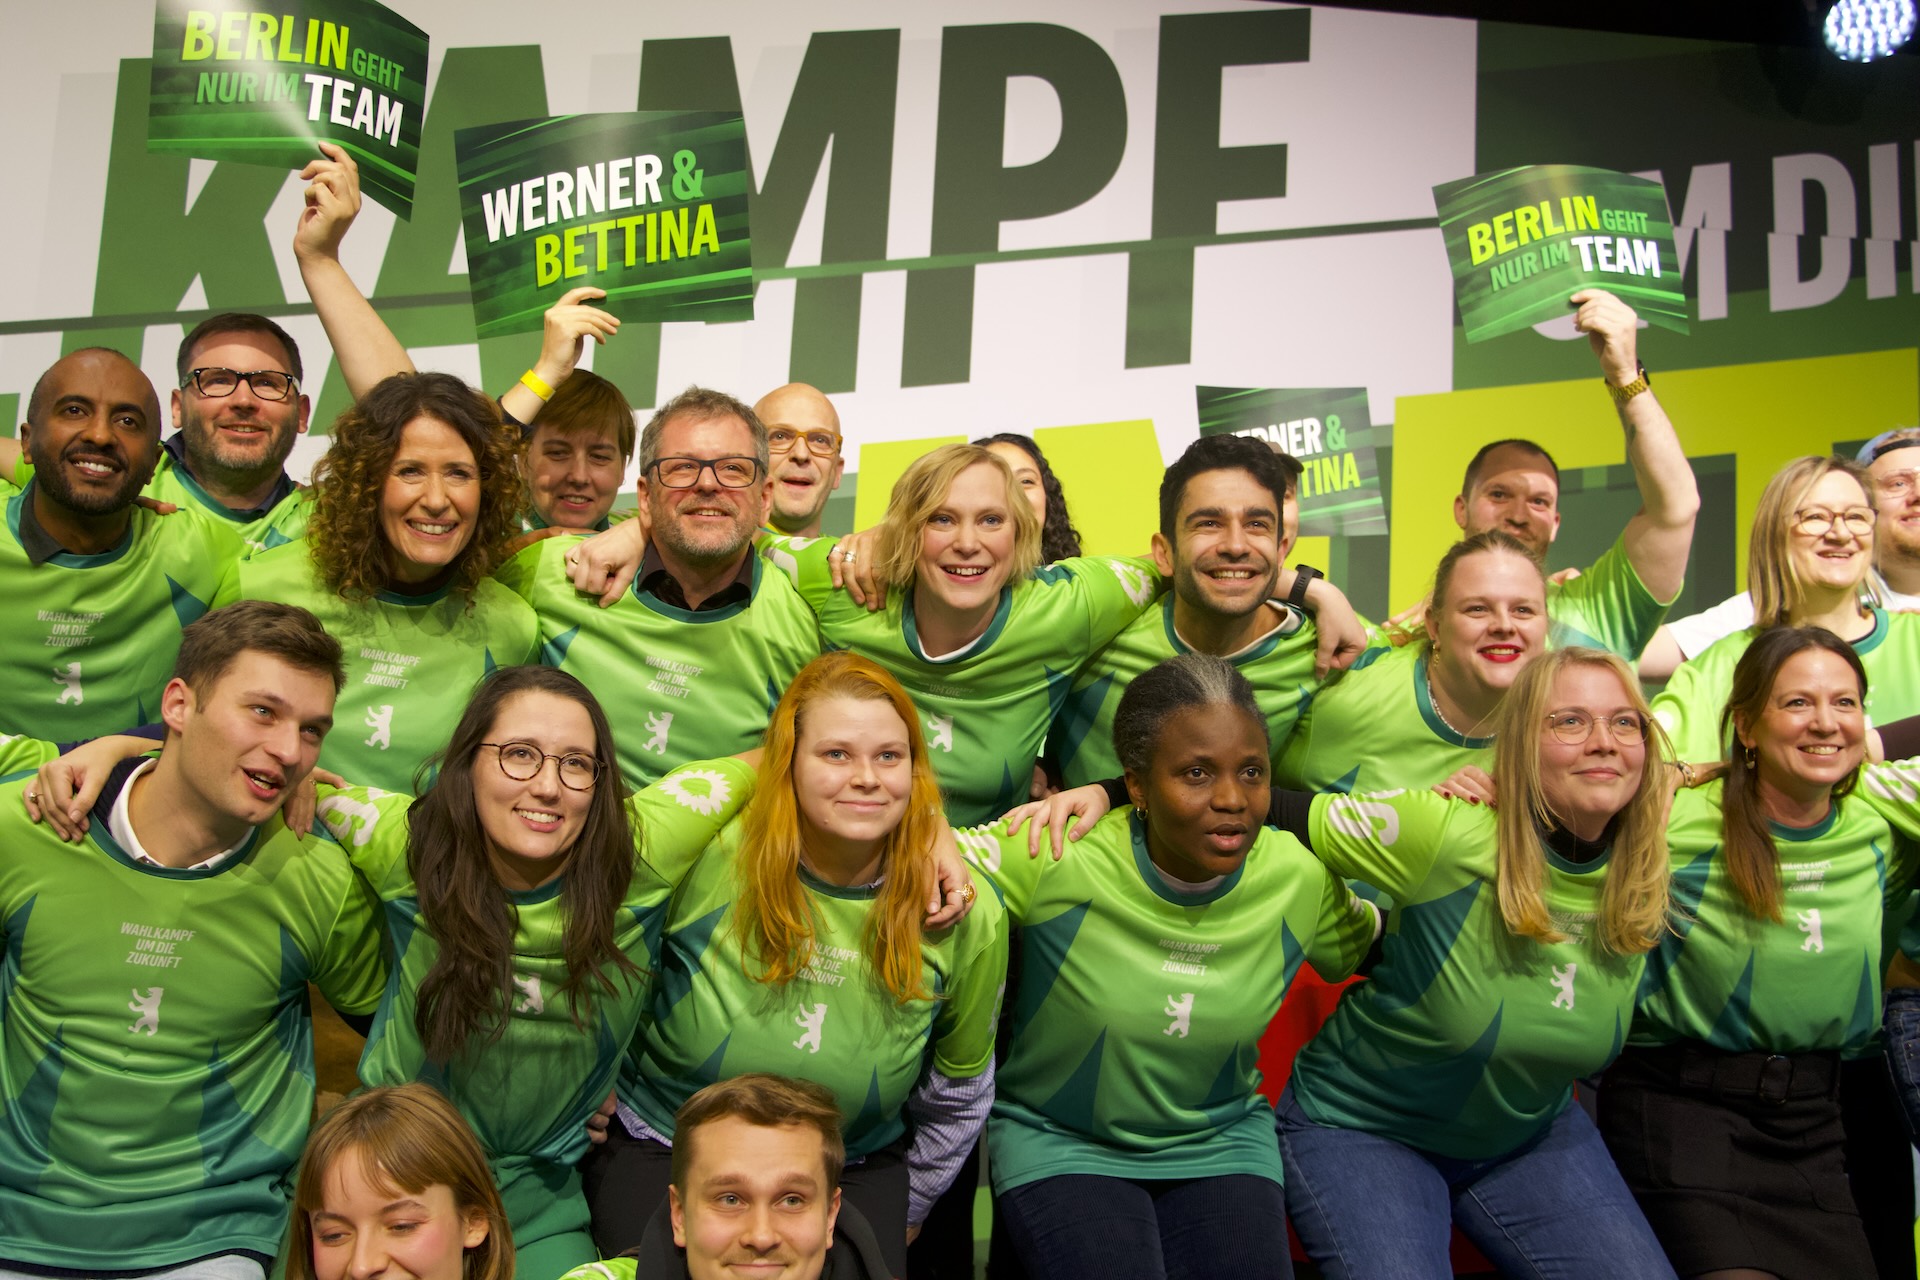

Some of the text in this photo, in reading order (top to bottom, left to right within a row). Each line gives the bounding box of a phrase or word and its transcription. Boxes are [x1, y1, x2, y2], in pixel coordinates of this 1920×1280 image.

[182, 10, 404, 92] BERLIN GEHT
[196, 71, 404, 148] NUR IM TEAM
[482, 149, 704, 244] WERNER &
[1467, 195, 1648, 266] BERLIN GEHT
[1768, 139, 1920, 313] DI
[535, 203, 721, 288] BETTINA
[1490, 235, 1661, 292] NUR IM TEAM
[1230, 414, 1347, 458] NER &
[1301, 452, 1361, 498] TINA
[37, 609, 105, 624] WAHLKAMPF
[52, 624, 90, 636] UM DIE
[44, 635, 95, 648] ZUKUNFT
[360, 647, 421, 667] WAHLKAMPF
[645, 655, 704, 677] WAHLKAMPF
[371, 662, 406, 677] UM DIE
[656, 670, 688, 687] UM DIE
[363, 672, 409, 690] ZUKUNFT
[646, 680, 691, 699] ZUKUNFT
[120, 921, 197, 942] WAHLKAMPF
[135, 938, 177, 955] UM DIE
[1158, 938, 1223, 954] WAHLKAMPF
[125, 951, 183, 969] ZUKUNFT
[823, 959, 843, 973] DIE
[1169, 950, 1205, 963] UM DIE
[797, 966, 847, 988] ZUKUNFT
[1161, 959, 1208, 977] ZUKUNFT
